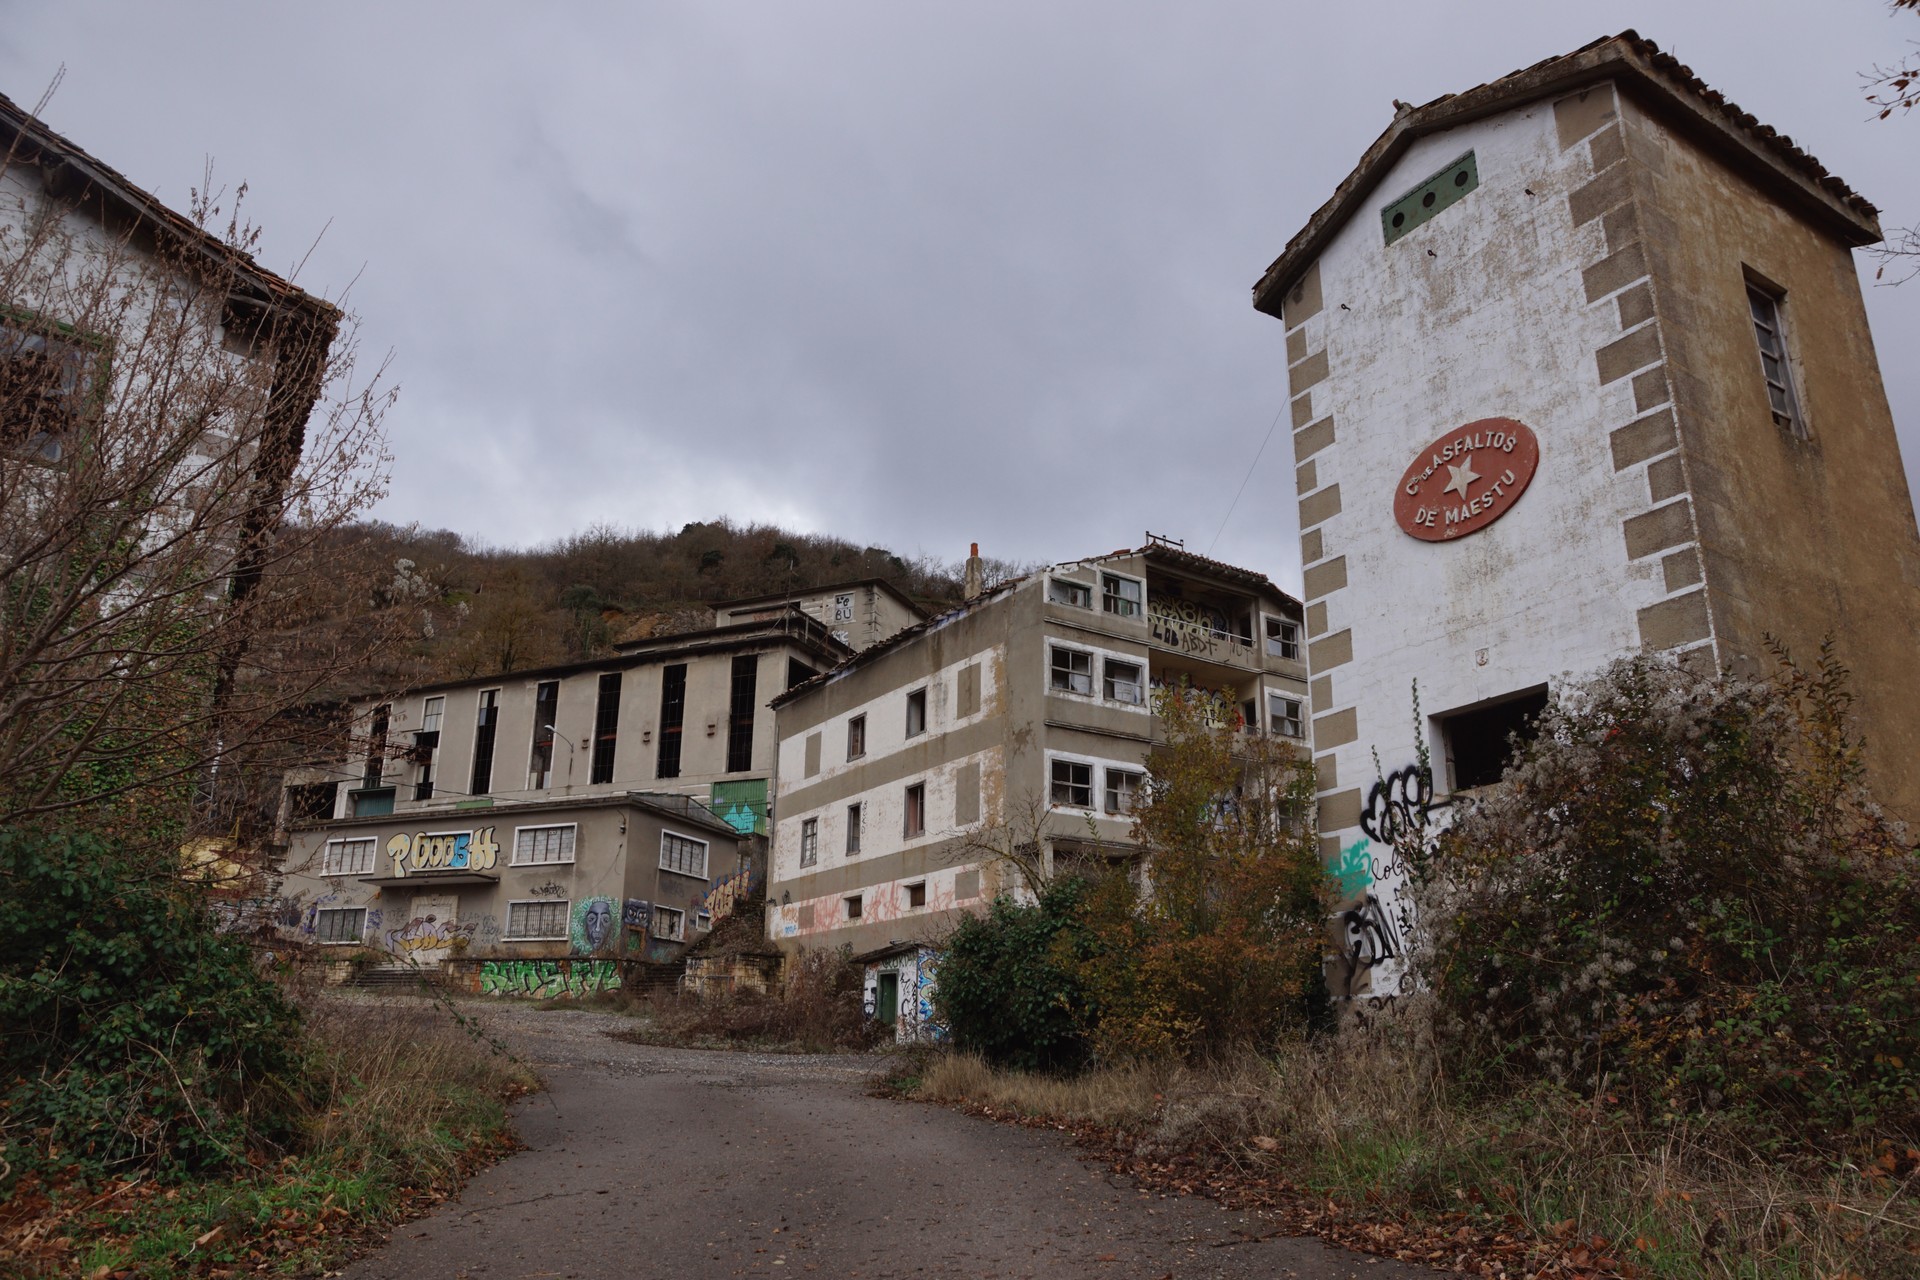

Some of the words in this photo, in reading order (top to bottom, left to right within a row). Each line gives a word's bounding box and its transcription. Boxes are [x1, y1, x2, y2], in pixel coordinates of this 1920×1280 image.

[1420, 465, 1434, 481] DE
[1432, 431, 1518, 470] ASFALTOS
[1414, 507, 1438, 528] DE
[1445, 469, 1516, 526] MAESTU
